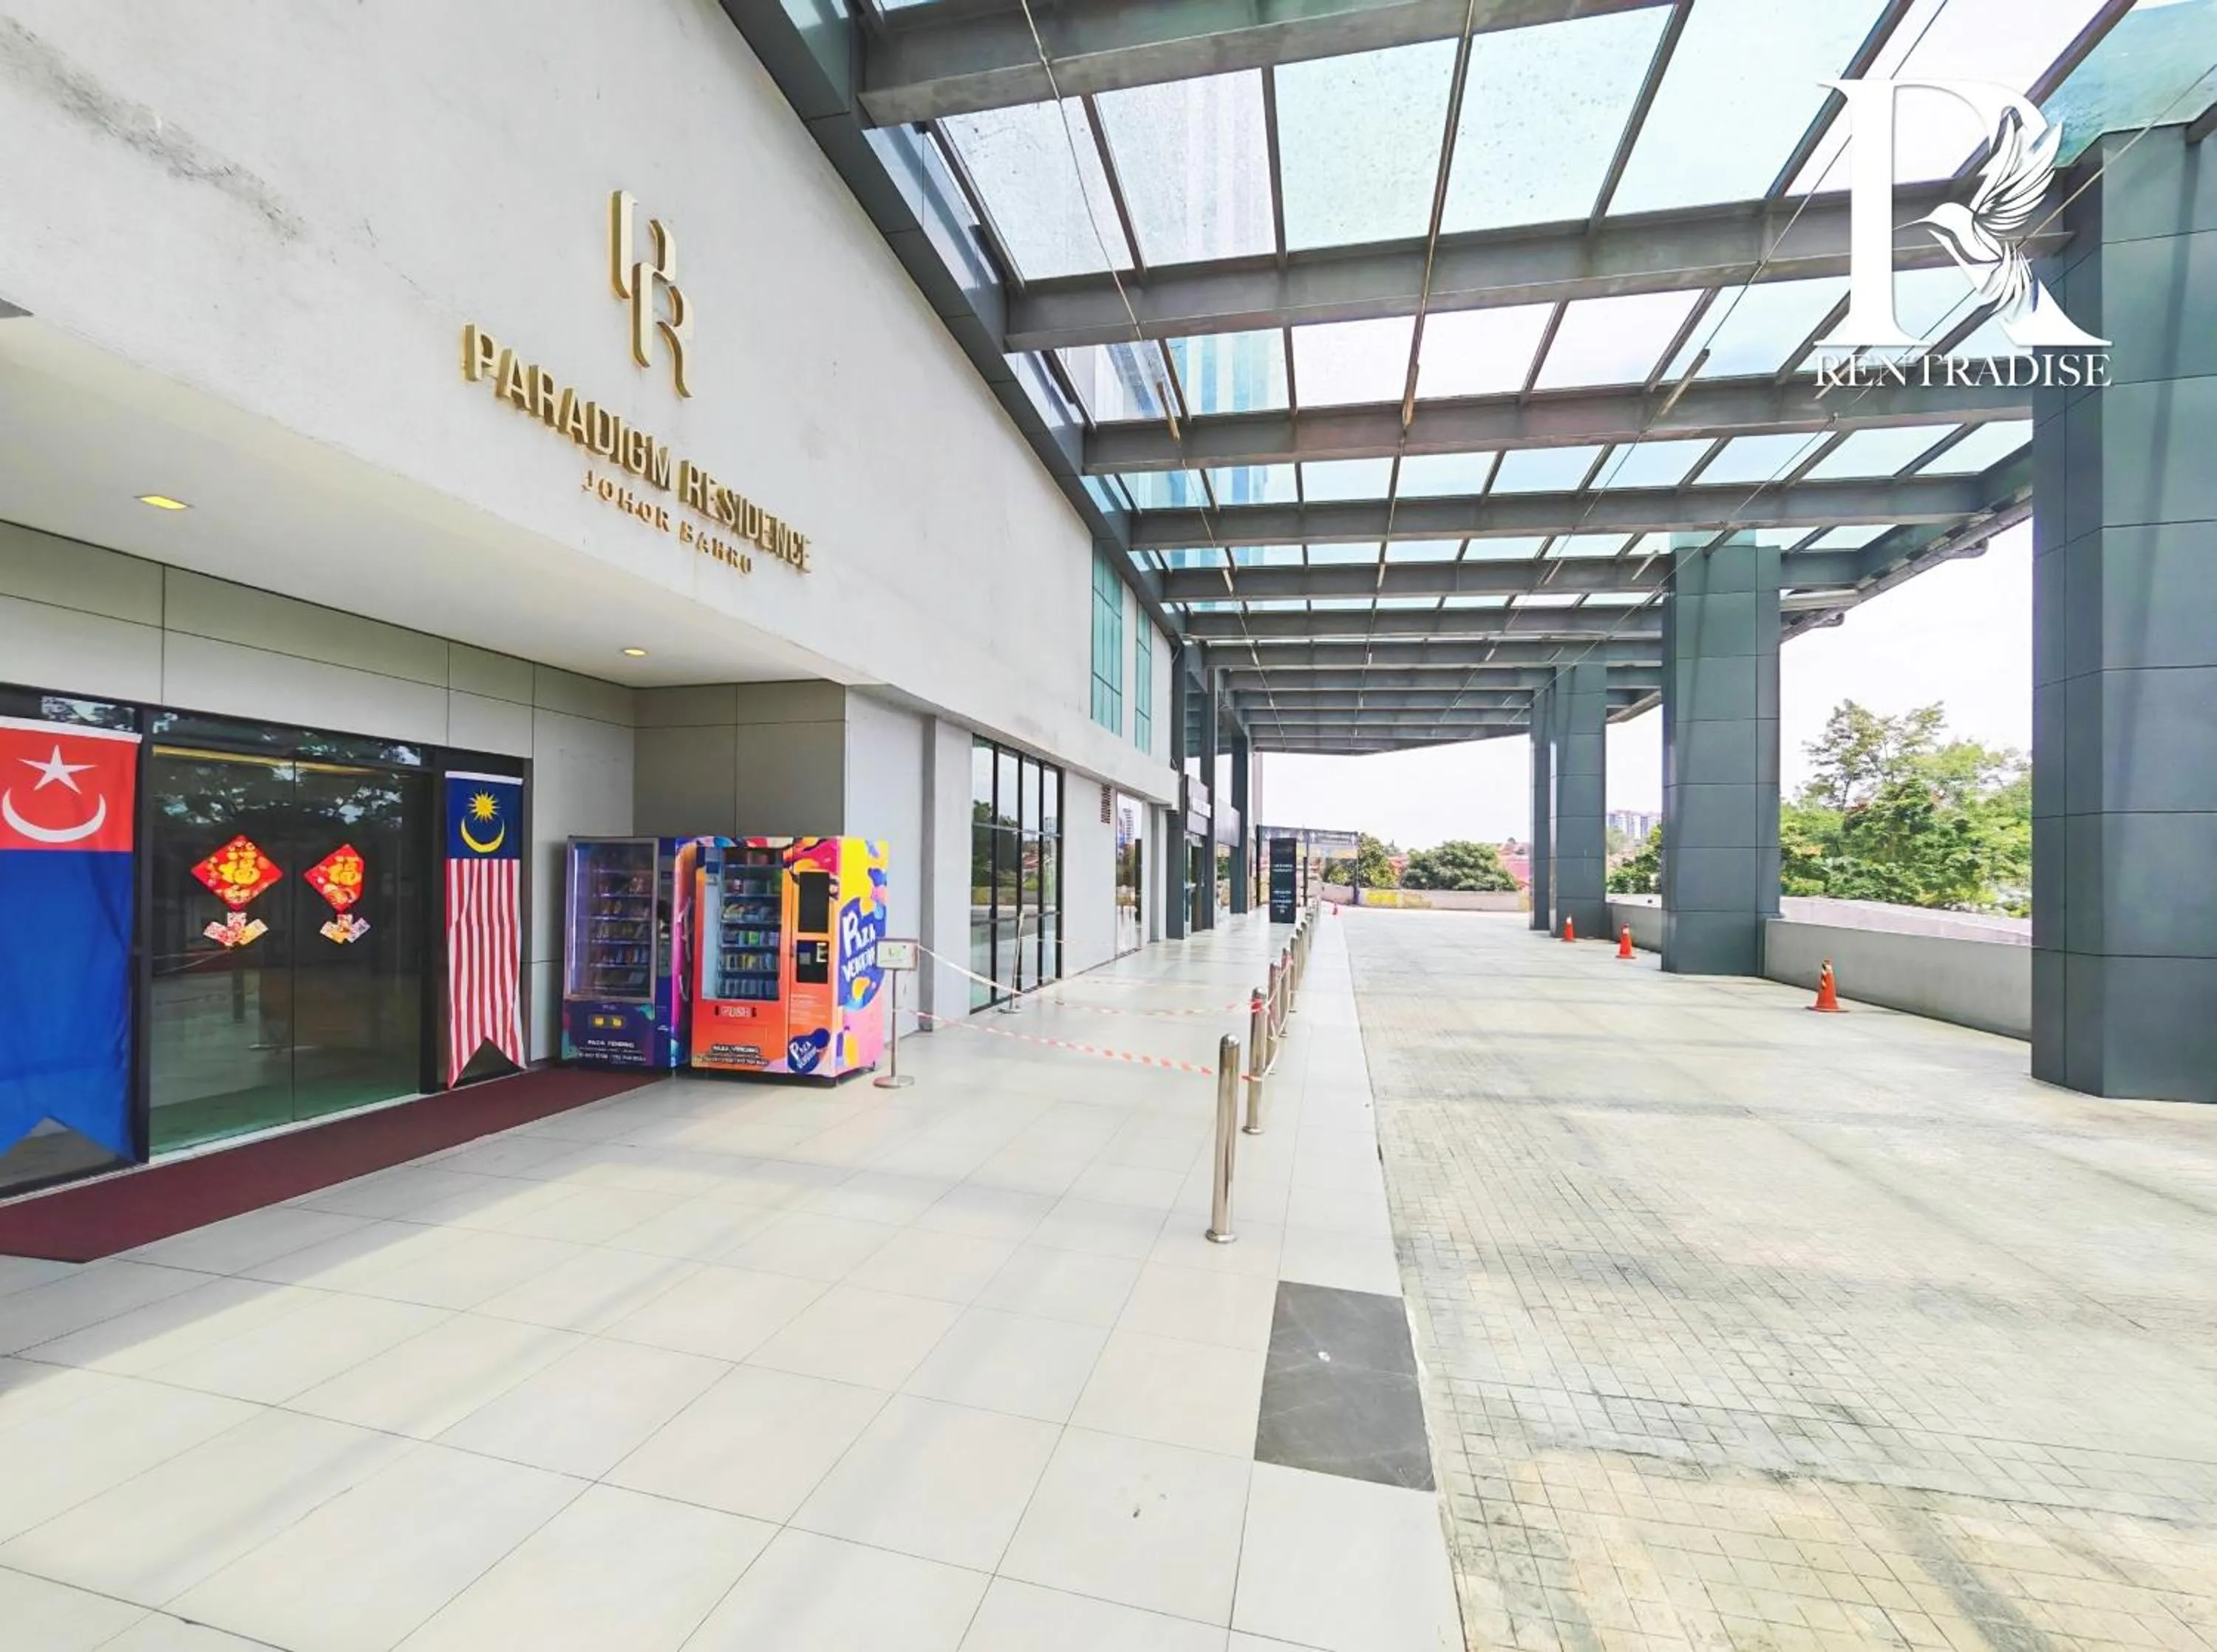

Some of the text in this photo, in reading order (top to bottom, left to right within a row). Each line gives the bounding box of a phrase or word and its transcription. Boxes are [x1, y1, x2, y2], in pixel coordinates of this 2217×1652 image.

[461, 322, 811, 573] PARADIGM RESIDENCE
[582, 470, 752, 575] JOHOR BAHRU
